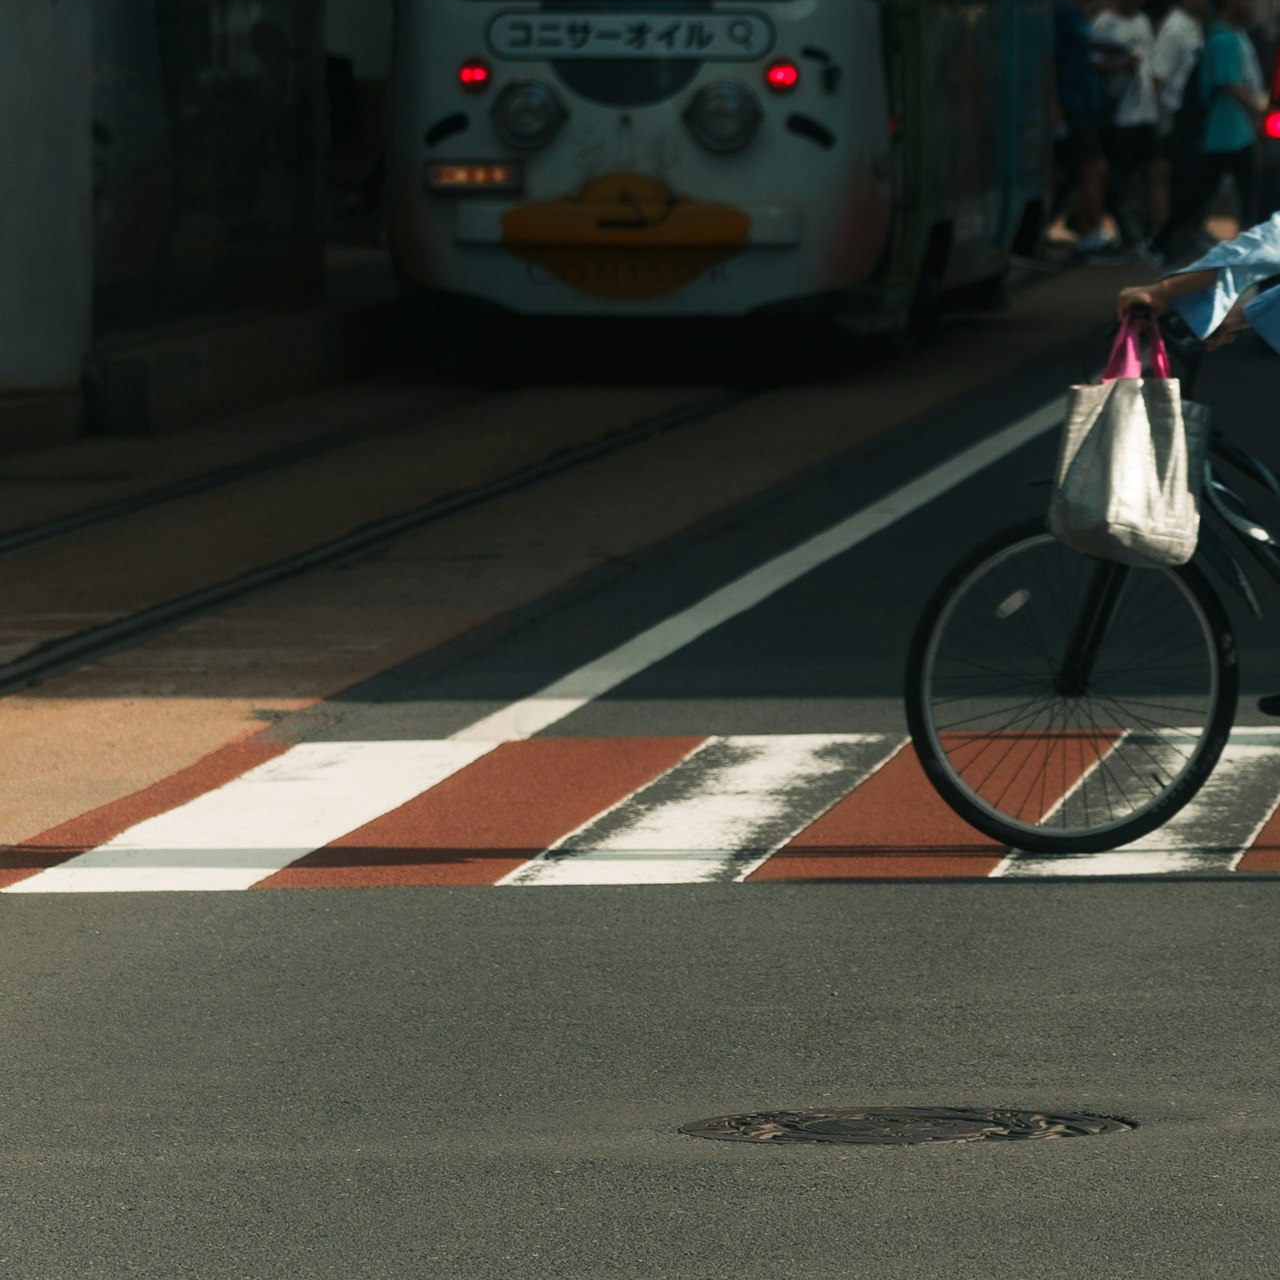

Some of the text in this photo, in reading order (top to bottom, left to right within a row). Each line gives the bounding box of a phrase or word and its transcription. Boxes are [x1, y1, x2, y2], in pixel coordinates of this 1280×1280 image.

[509, 21, 715, 49] コニサーオイル
